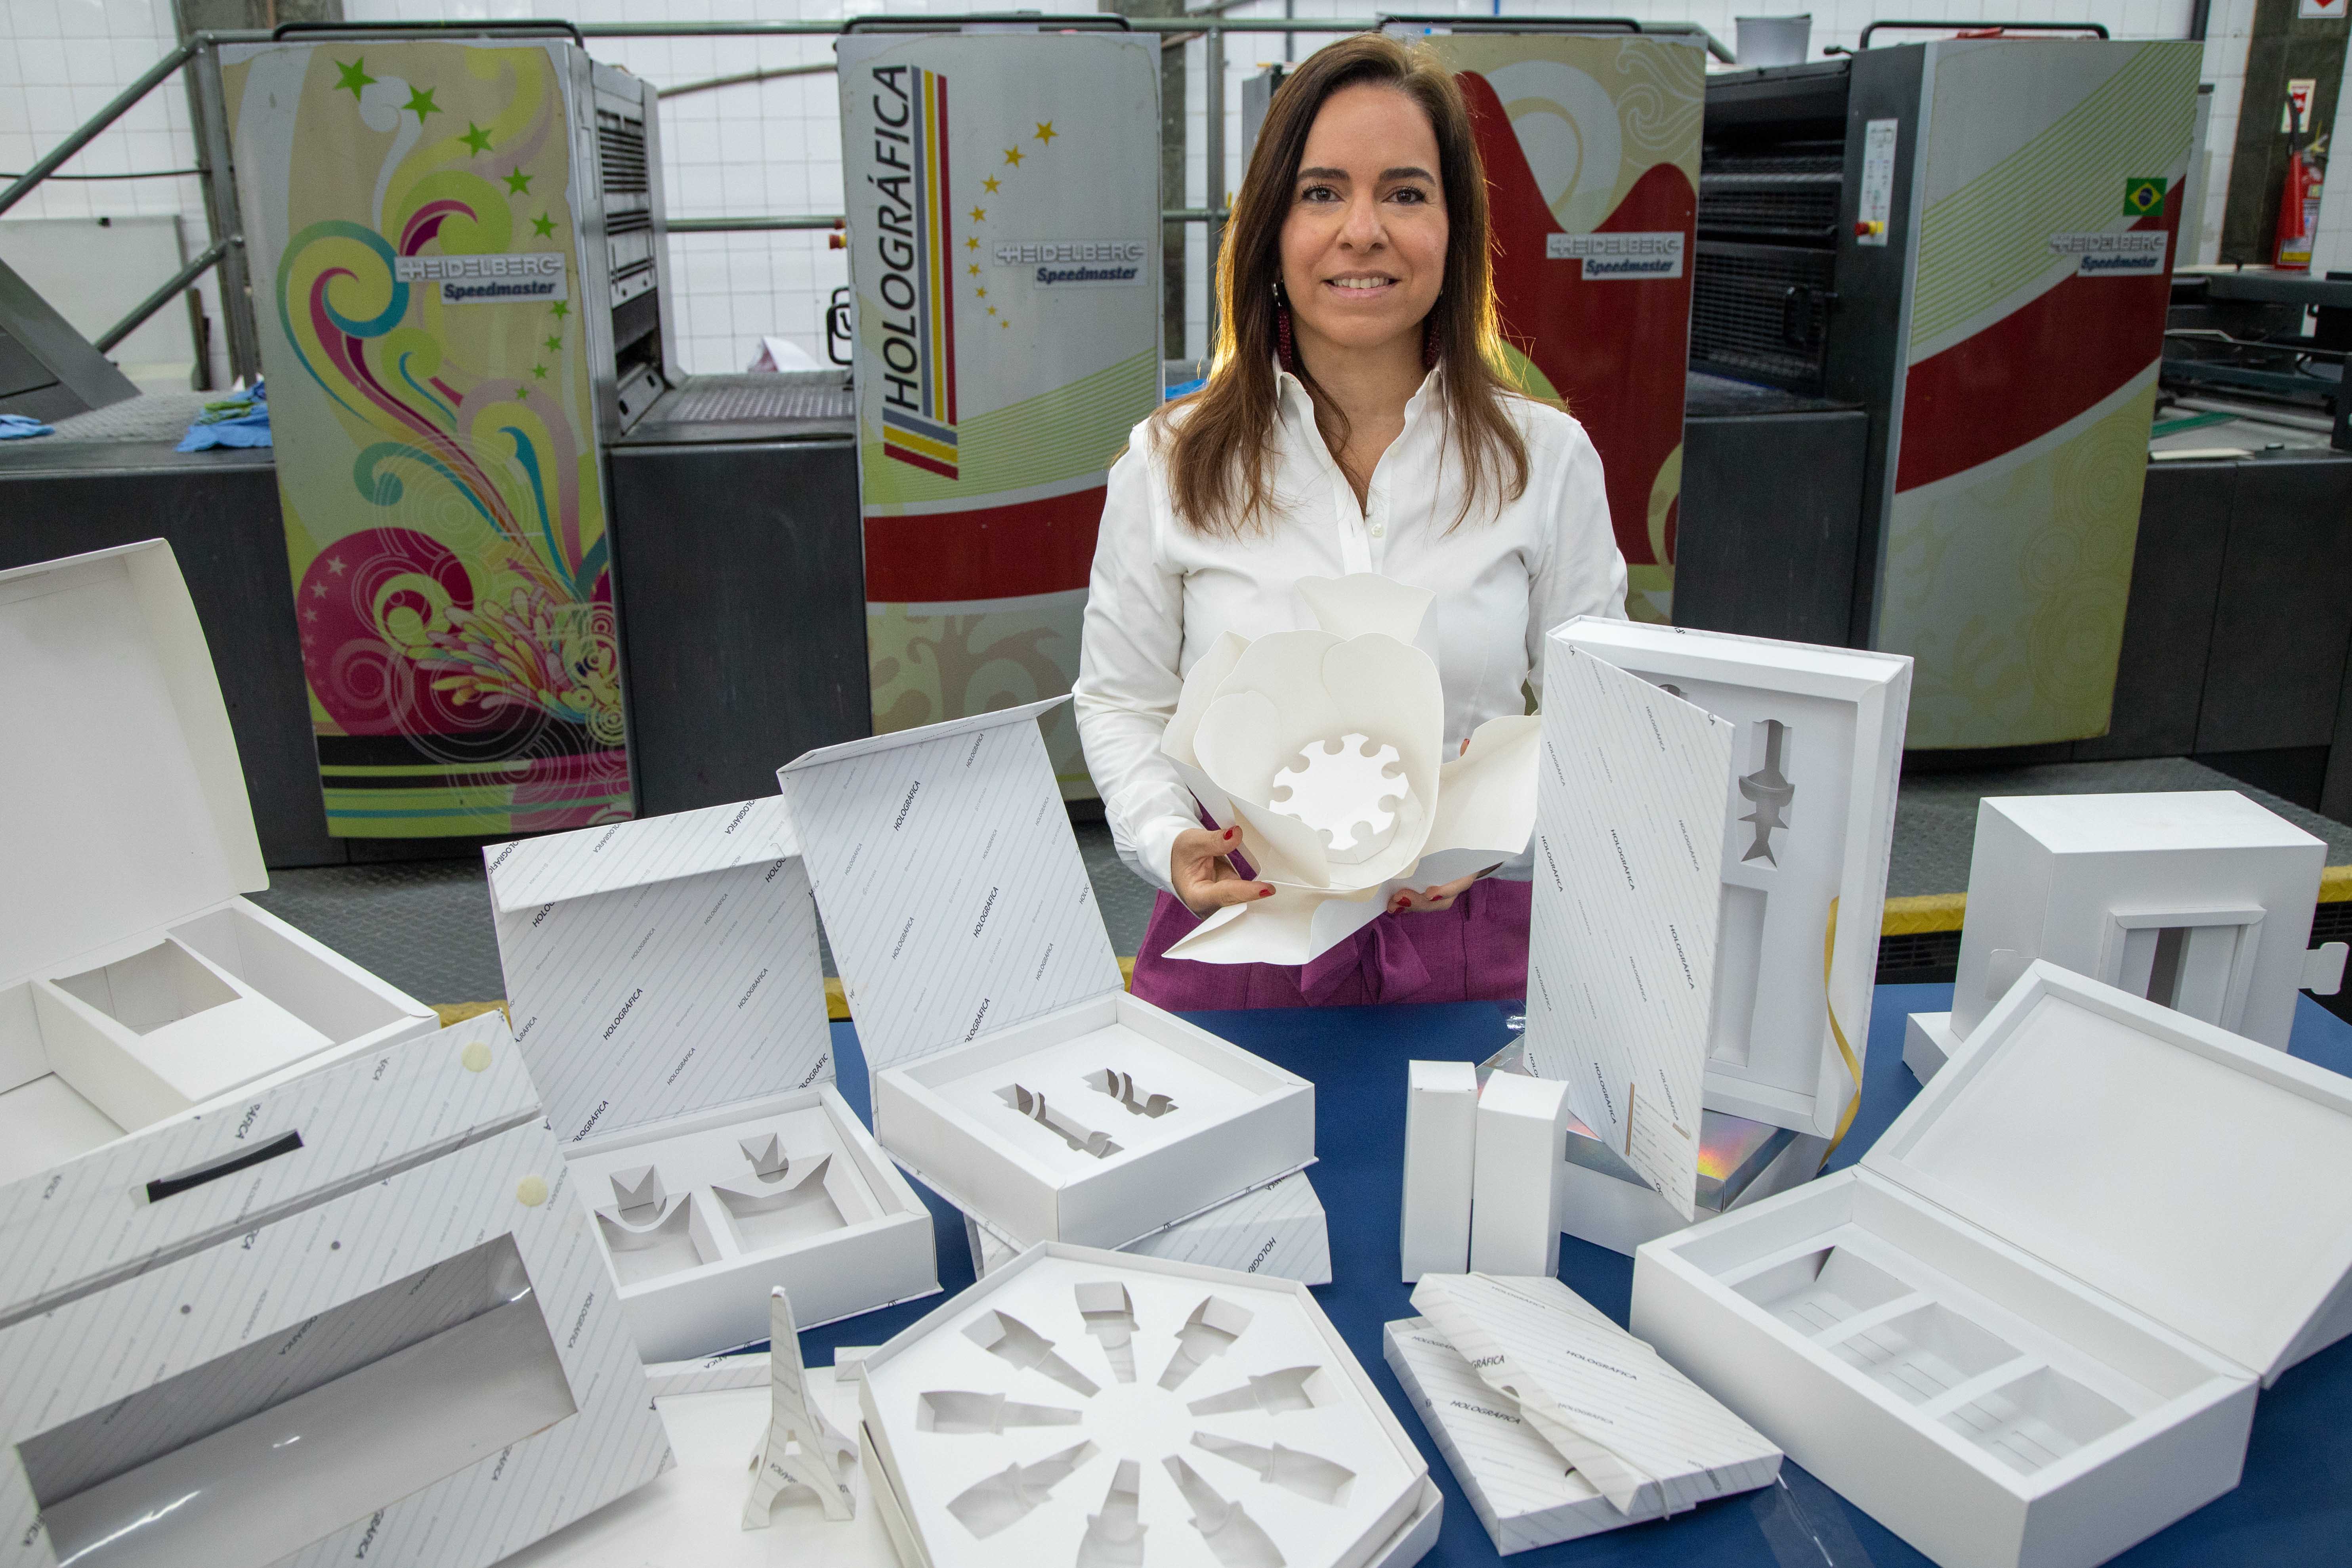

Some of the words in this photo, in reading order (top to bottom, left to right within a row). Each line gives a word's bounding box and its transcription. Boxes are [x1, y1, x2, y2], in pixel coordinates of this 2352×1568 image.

[868, 65, 919, 411] HOLOGRÁFICA
[996, 244, 1145, 264] HEIDELBERG
[1550, 239, 1680, 256] HEIDELBERG
[2050, 237, 2165, 252] HEIDELBERG
[400, 256, 561, 278] HEIDELBERG
[1037, 266, 1138, 284] Speedmaster
[1586, 259, 1674, 276] Speedmaster
[2081, 255, 2158, 271] Speedmaster
[444, 280, 556, 300] Speedmaster
[966, 732, 985, 769] HOLOGRÁFICA
[724, 798, 756, 835] OLOGRÁFICA
[893, 780, 920, 832] HOLOGRÁFICA
[593, 823, 621, 853] OLOGRÁFICA
[1541, 835, 1564, 892] HOLOGRÁFICA
[1610, 829, 1635, 891] HOLOGRÁFICA
[703, 892, 729, 926] HOLOGRÁFICA
[973, 886, 999, 939] HOLOGRÁFICA
[630, 927, 656, 960] HOLOGRÁFICA
[892, 916, 914, 961] HOLOGRÁFICA
[1669, 924, 1695, 990] HOLOGRÁFICA
[1035, 942, 1054, 982] HOLOGRÁFICA
[737, 967, 769, 1010] HOLOGRÁFICA
[603, 987, 643, 1041] HOLOGRÁFICA
[666, 1047, 697, 1087] HOLOGRÁFICA
[1594, 1062, 1617, 1125] HOLOGRÁFICA
[1449, 1400, 1522, 1425] HOLOGRÁFICA
